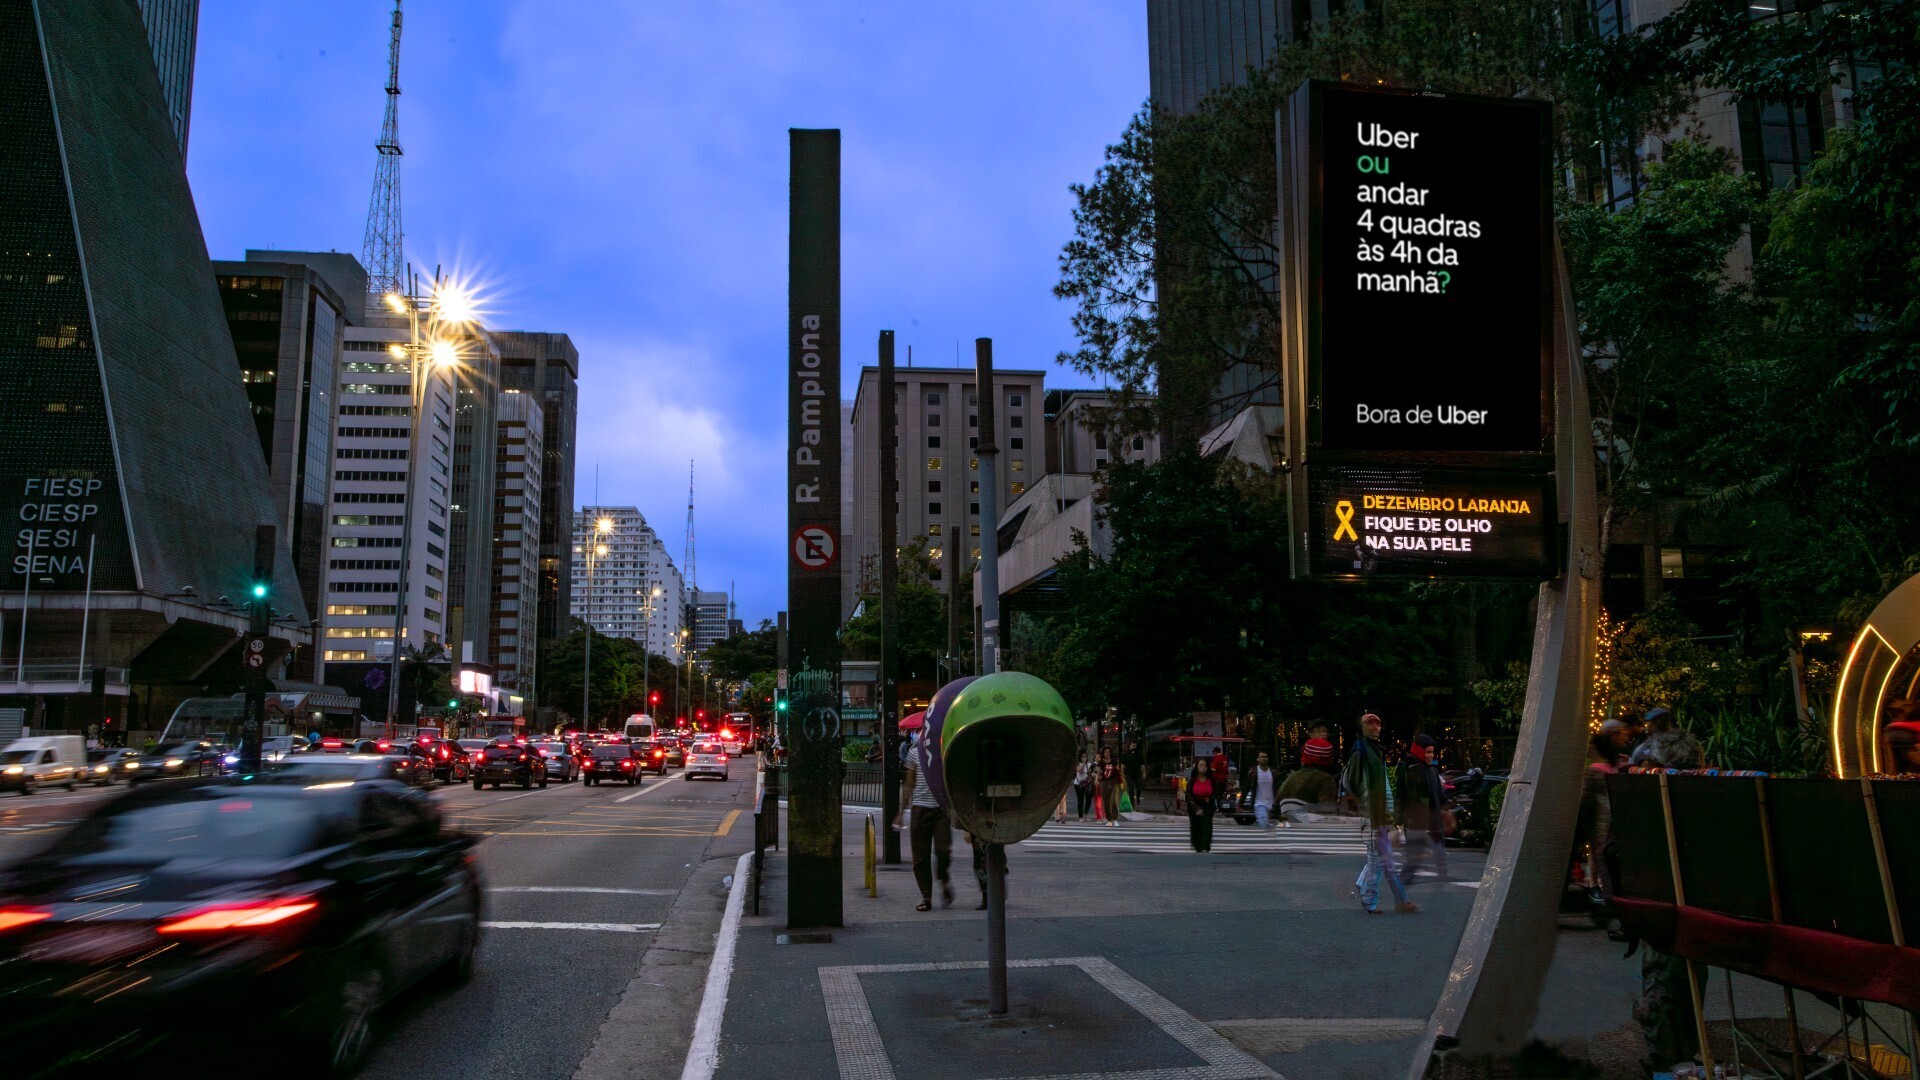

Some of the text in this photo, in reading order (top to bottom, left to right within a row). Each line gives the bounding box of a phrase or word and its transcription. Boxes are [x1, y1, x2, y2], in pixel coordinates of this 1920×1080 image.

[1357, 121, 1420, 149] Uber
[1357, 155, 1389, 174] ou
[1357, 182, 1430, 206] andar
[1357, 209, 1481, 239] 4 quadras
[1357, 237, 1459, 266] às 4h da
[1357, 269, 1451, 294] manhã?
[796, 314, 825, 503] R. Pamplona
[1356, 404, 1489, 425] Bora de Uber
[23, 478, 103, 497] FIESP
[18, 502, 99, 523] CIESP
[1363, 495, 1531, 514] DEZEMBRO LARANJA
[1364, 515, 1492, 533] FIQUE DE OLHO
[16, 528, 78, 548] SESI
[1365, 535, 1472, 552] NA SUA PELE
[252, 641, 263, 649] 50
